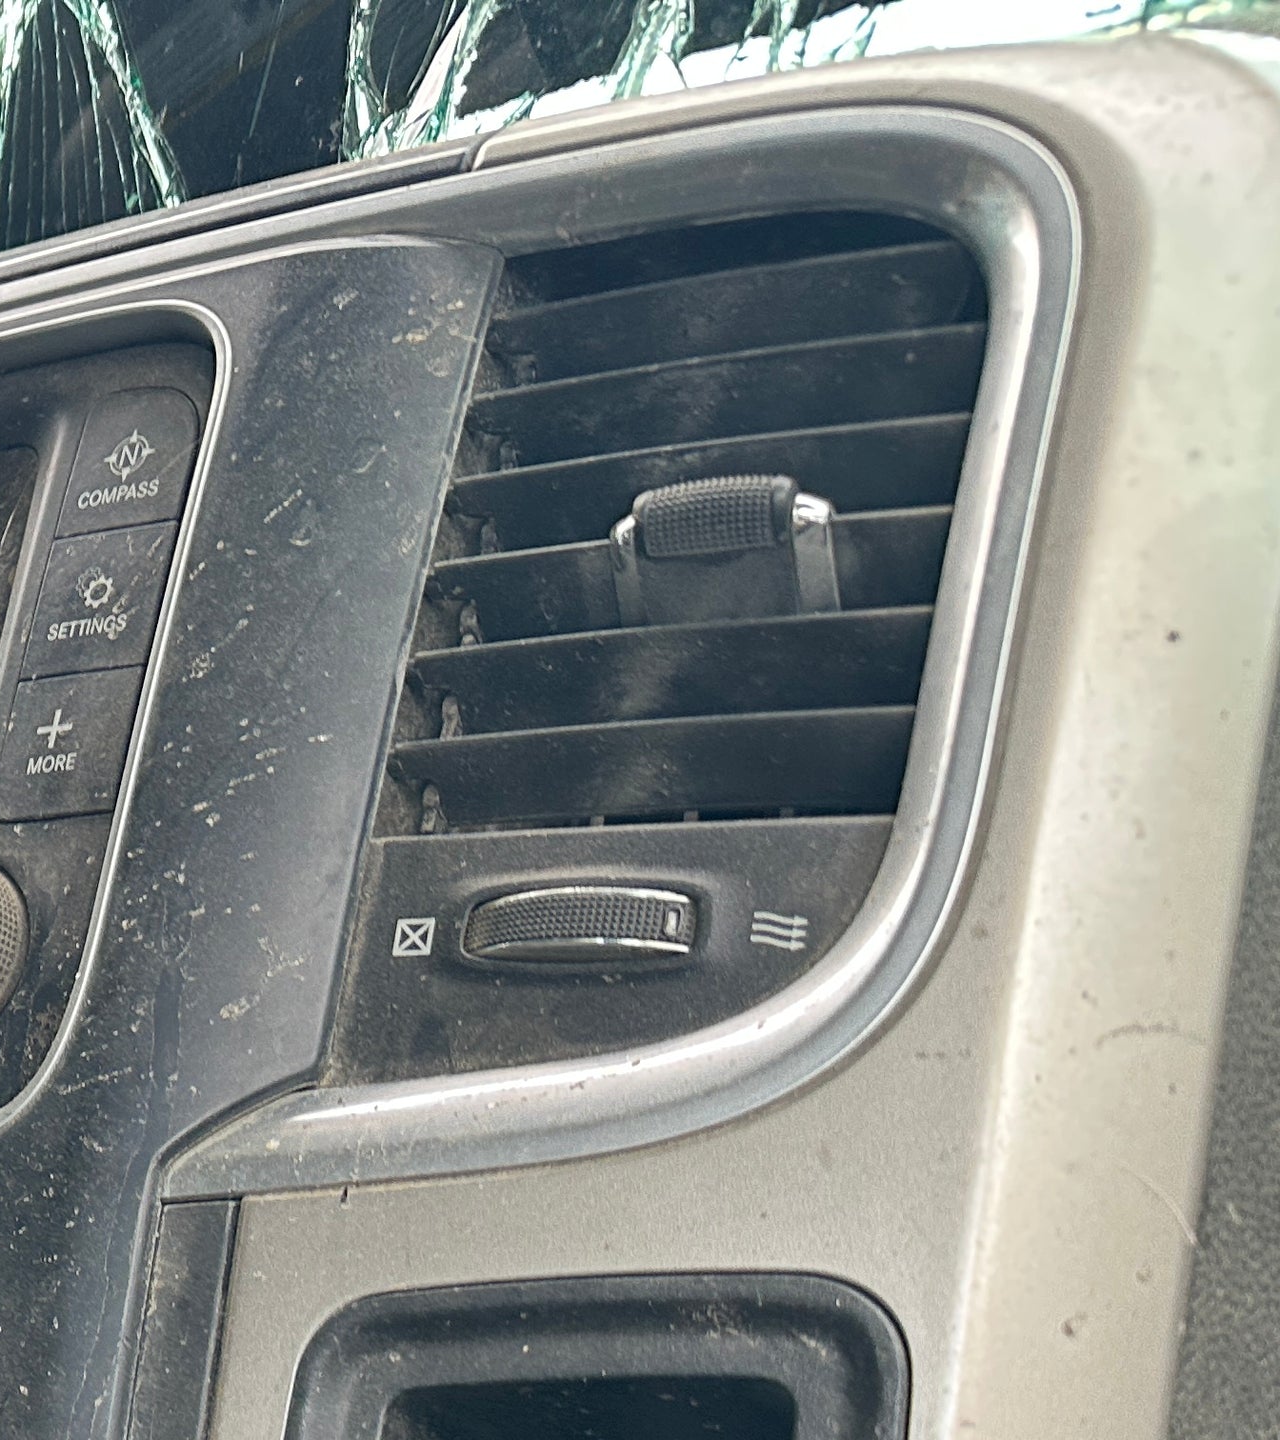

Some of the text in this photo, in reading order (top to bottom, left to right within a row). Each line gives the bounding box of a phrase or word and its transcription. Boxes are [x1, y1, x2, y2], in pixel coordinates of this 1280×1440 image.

[77, 480, 159, 509] COMPASS
[47, 614, 127, 642] SETTINGS
[26, 752, 77, 775] MORE
